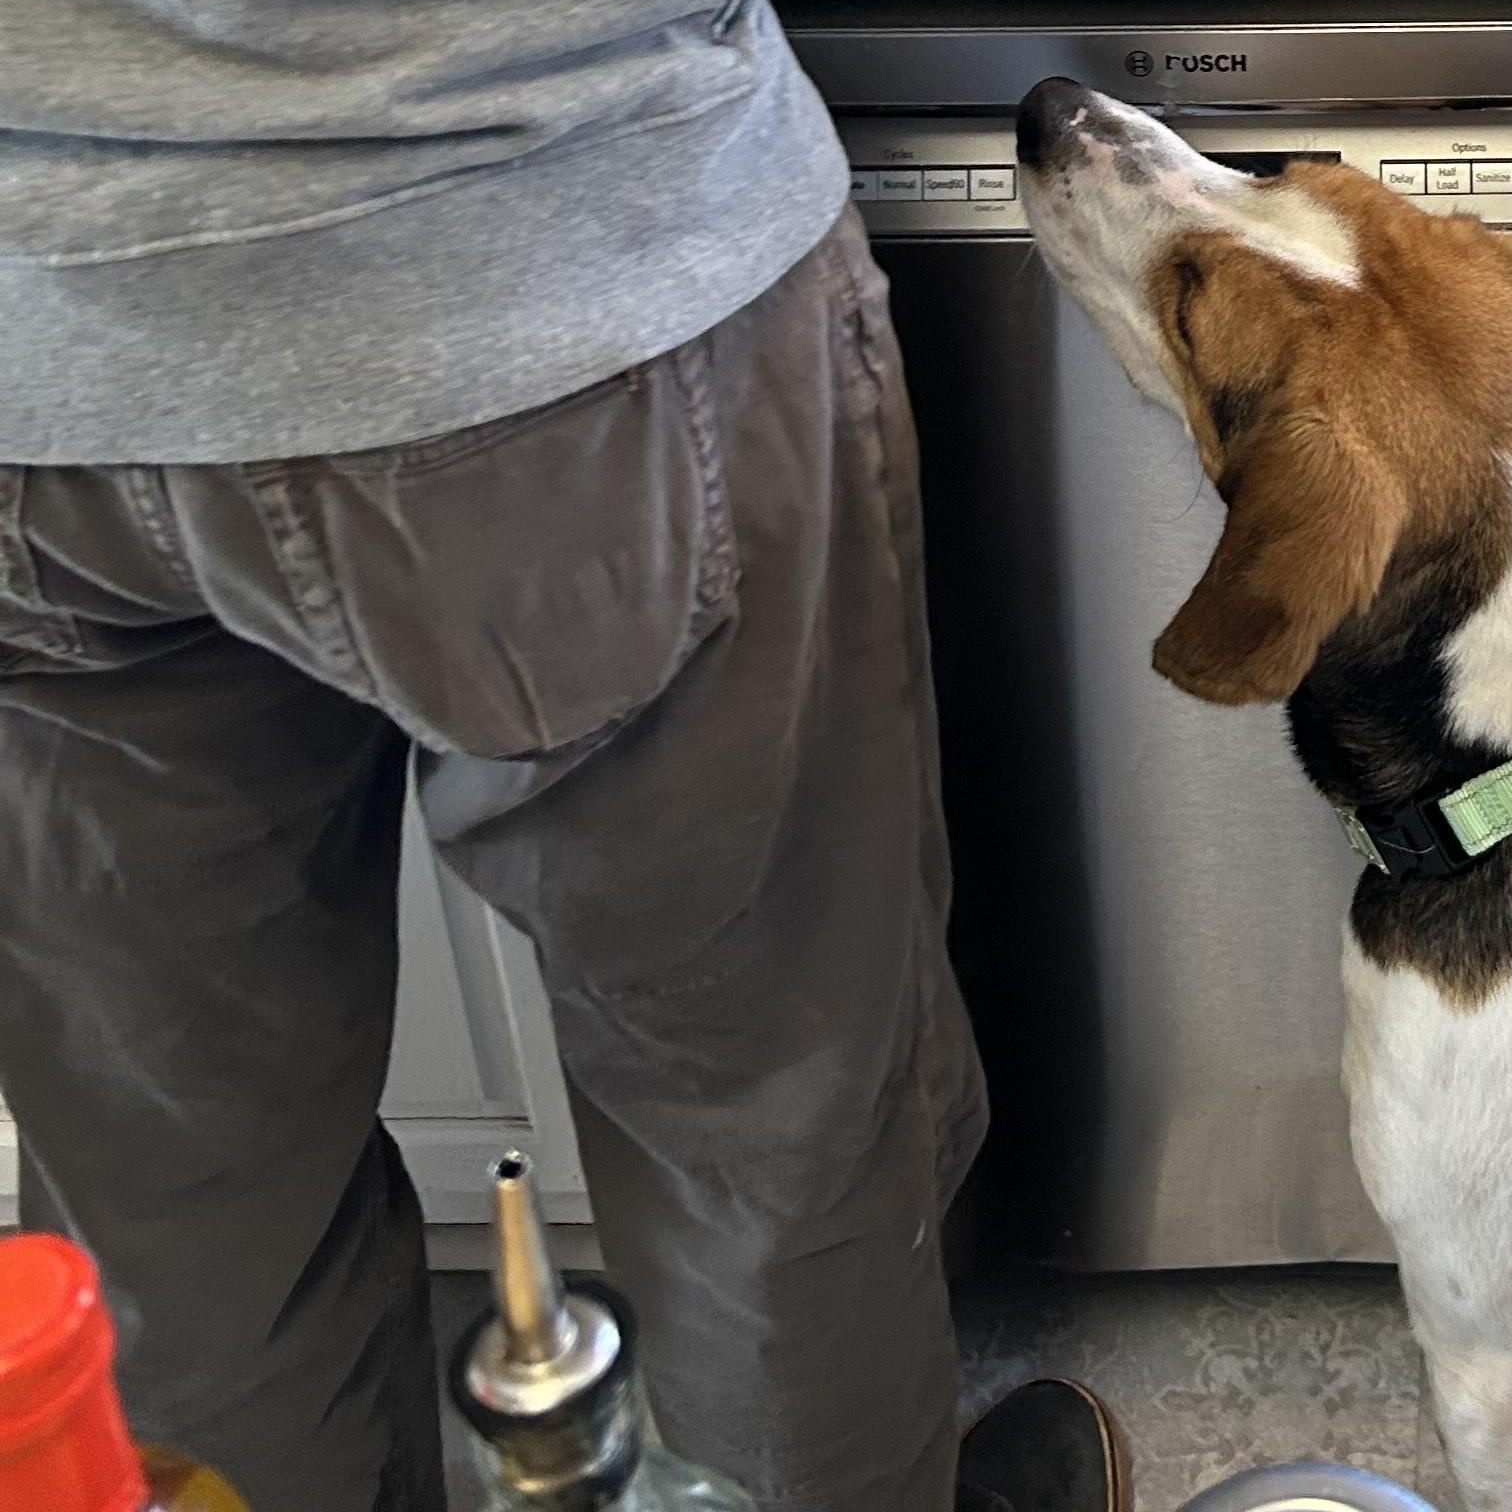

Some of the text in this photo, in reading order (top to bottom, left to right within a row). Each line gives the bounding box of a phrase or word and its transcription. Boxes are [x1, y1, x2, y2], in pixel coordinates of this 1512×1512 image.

[1451, 142, 1488, 154] Options
[1438, 167, 1458, 177] Half
[1475, 172, 1512, 184] Sanitize
[1389, 173, 1416, 186] Delay
[1436, 179, 1460, 190] Load
